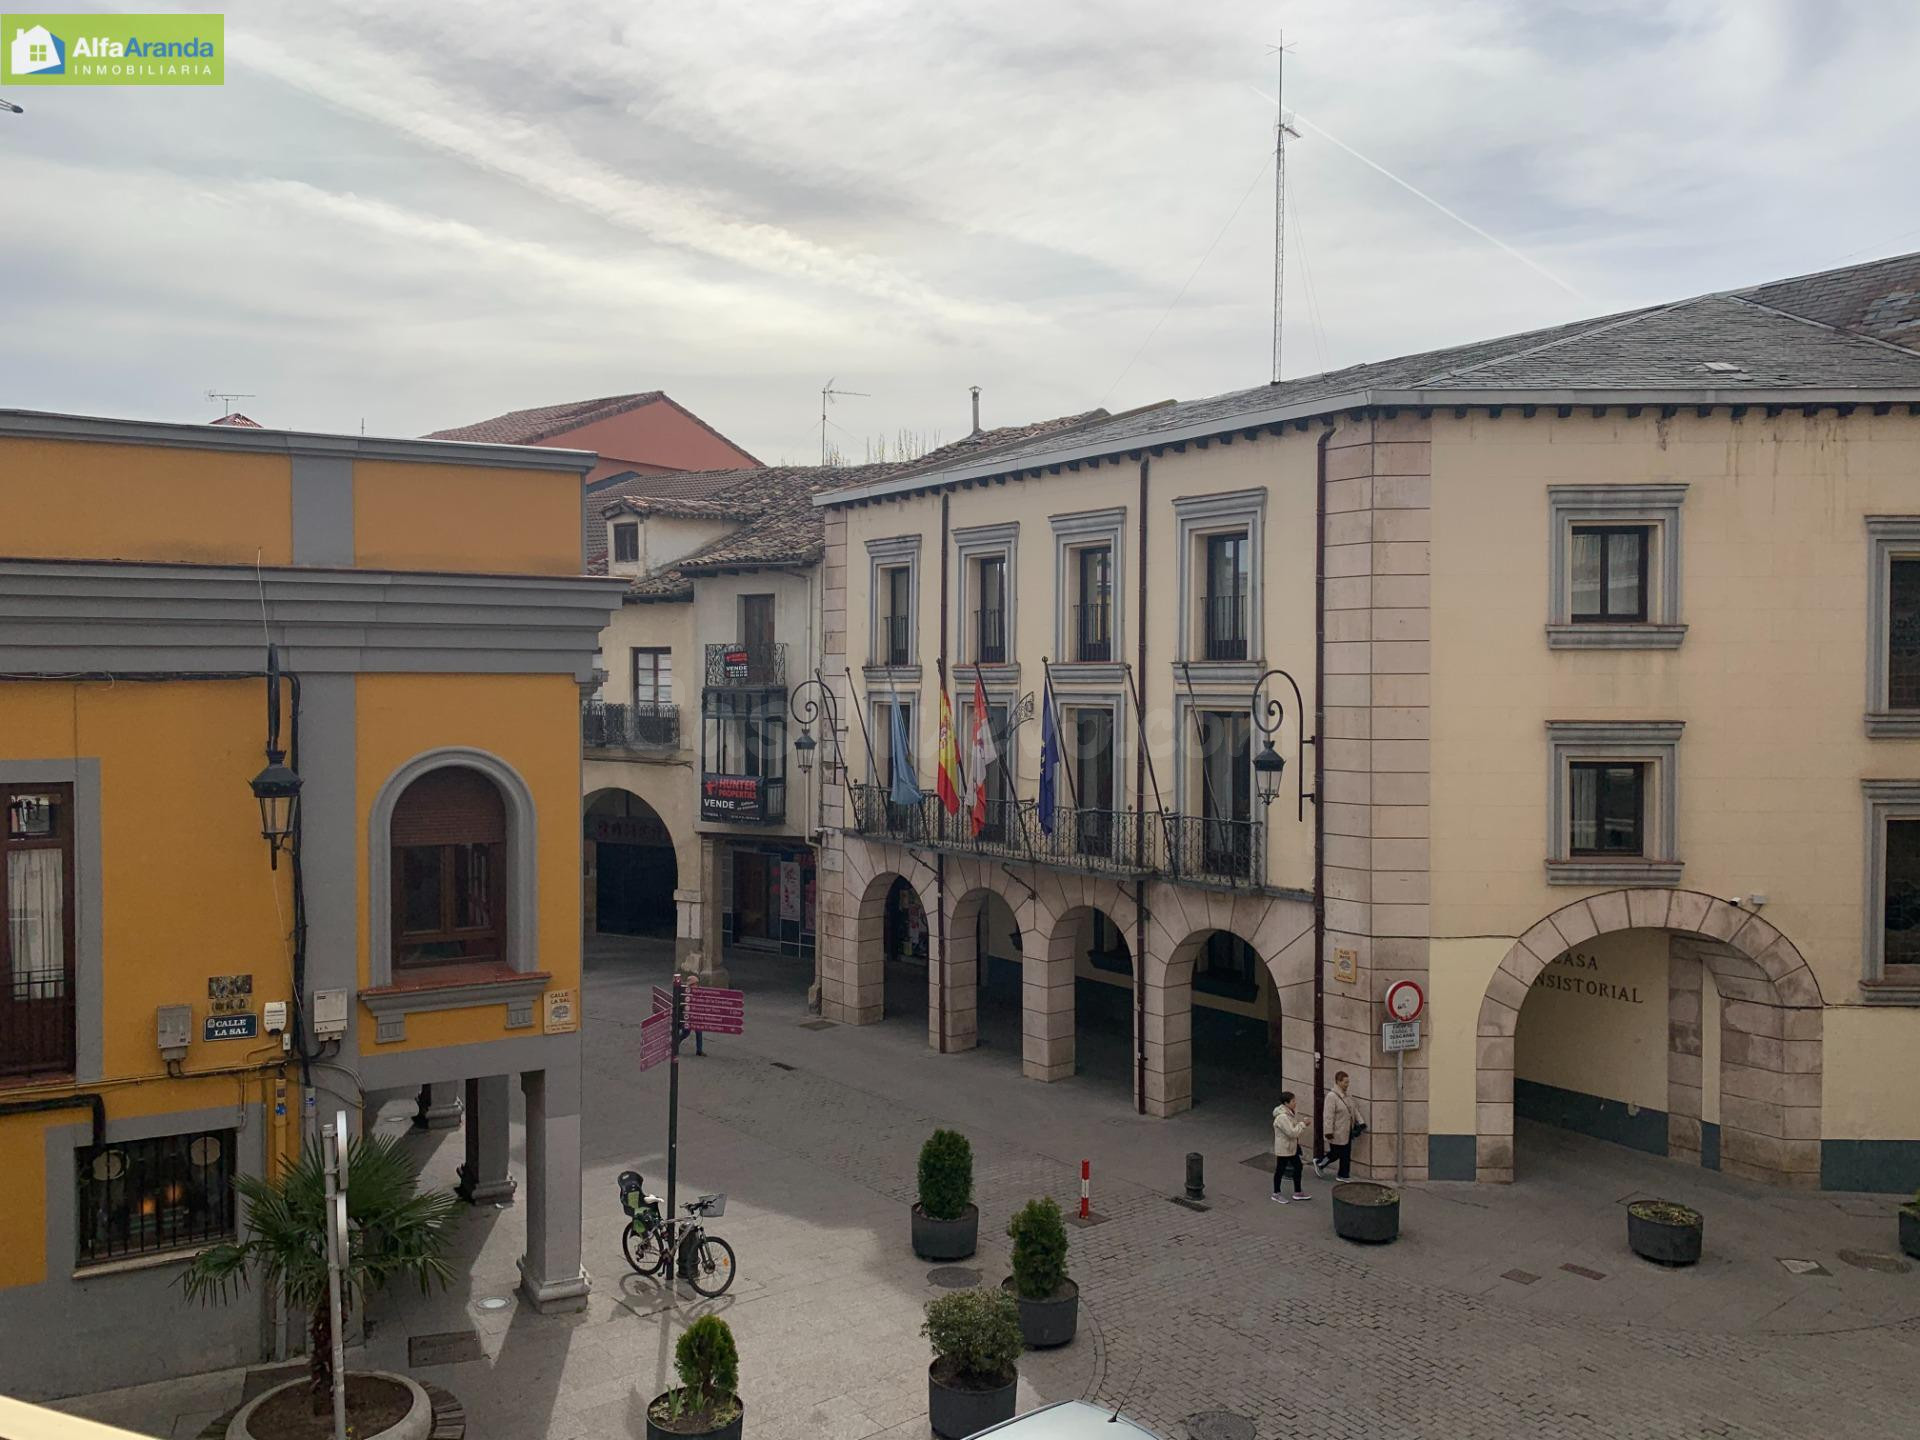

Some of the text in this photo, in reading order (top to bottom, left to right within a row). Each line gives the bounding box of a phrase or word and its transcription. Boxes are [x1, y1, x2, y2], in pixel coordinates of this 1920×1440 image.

[719, 778, 757, 791] HUNTER
[719, 790, 757, 800] PROPERTIES
[704, 799, 735, 809] VENDE
[1534, 973, 1643, 1003] NSISTORIAL
[215, 1019, 247, 1028] CALLE
[214, 1027, 249, 1037] LA SAL
